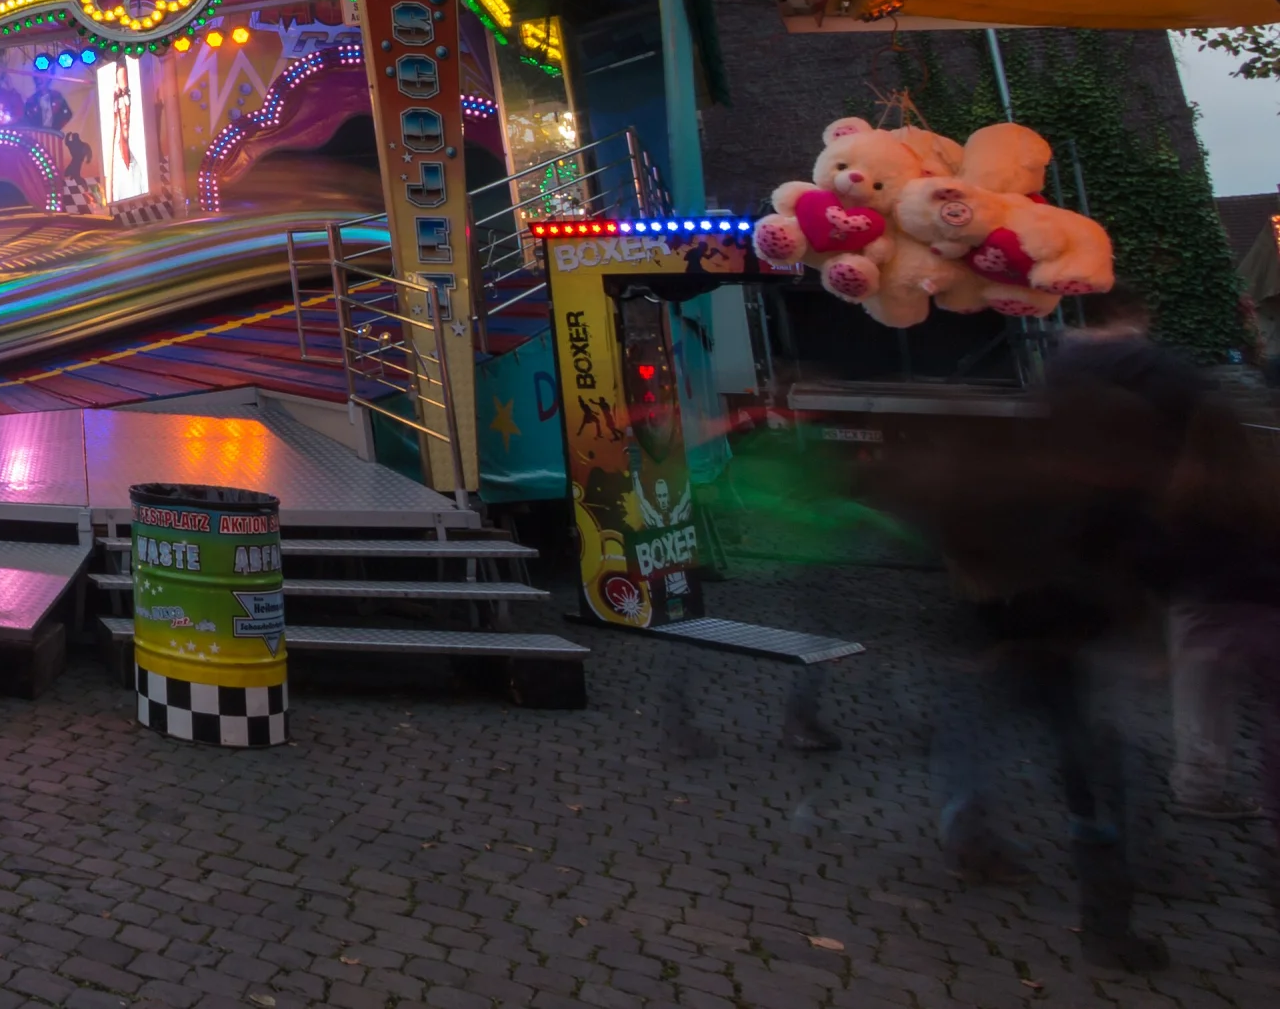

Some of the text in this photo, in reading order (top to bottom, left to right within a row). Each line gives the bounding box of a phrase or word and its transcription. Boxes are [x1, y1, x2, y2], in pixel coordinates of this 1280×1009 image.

[555, 234, 671, 272] BOXER
[566, 310, 596, 390] BOXER
[139, 505, 210, 532] FESTPLATZ
[219, 515, 267, 534] AKTION
[137, 535, 201, 571] WASTE
[635, 525, 698, 577] BOXER
